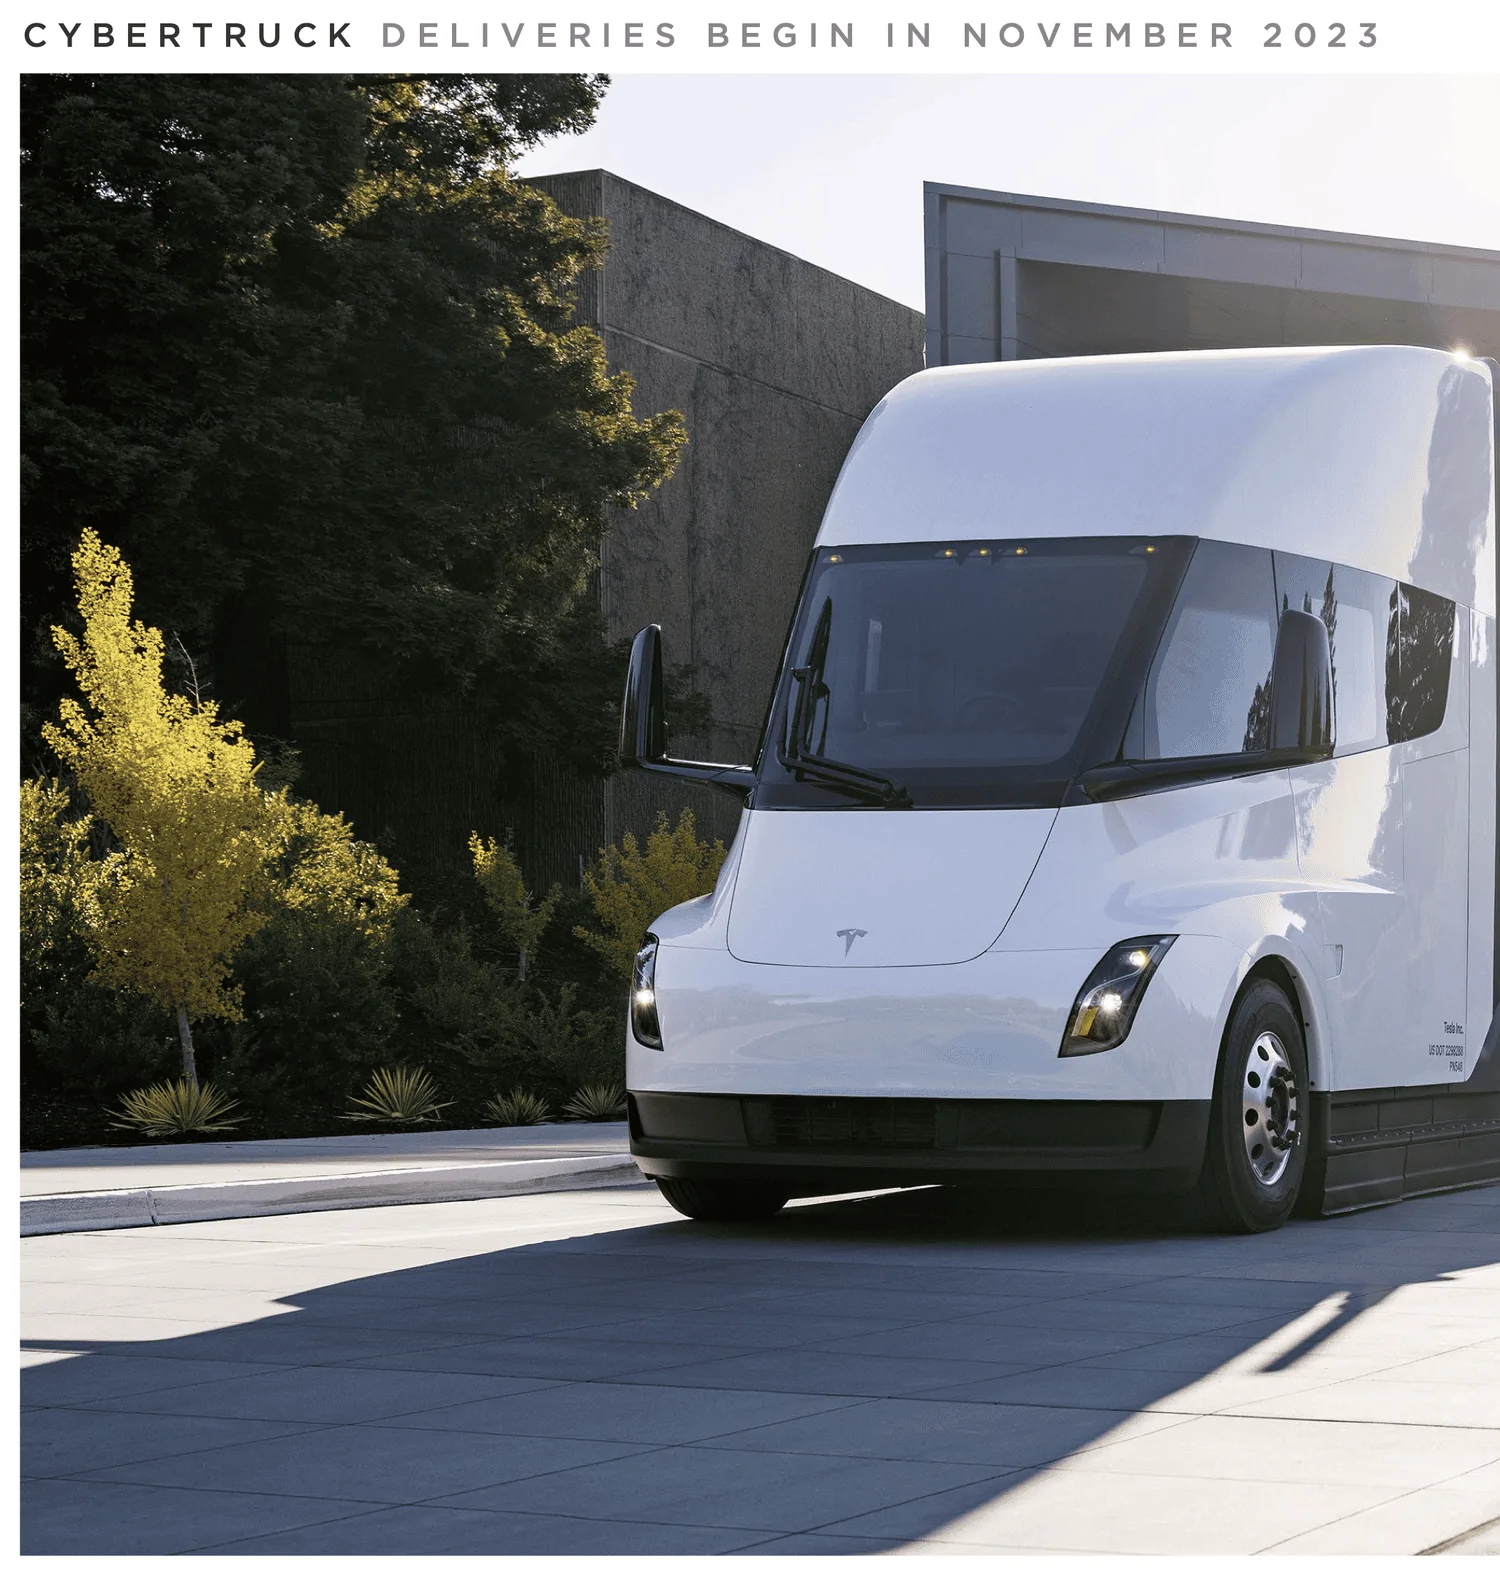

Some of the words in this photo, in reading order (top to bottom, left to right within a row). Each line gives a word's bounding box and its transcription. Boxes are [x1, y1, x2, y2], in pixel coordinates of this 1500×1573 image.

[1443, 1021, 1456, 1034] Tesla
[1456, 1022, 1464, 1034] Inc.
[1428, 1044, 1435, 1056] US
[1436, 1045, 1445, 1056] DOT
